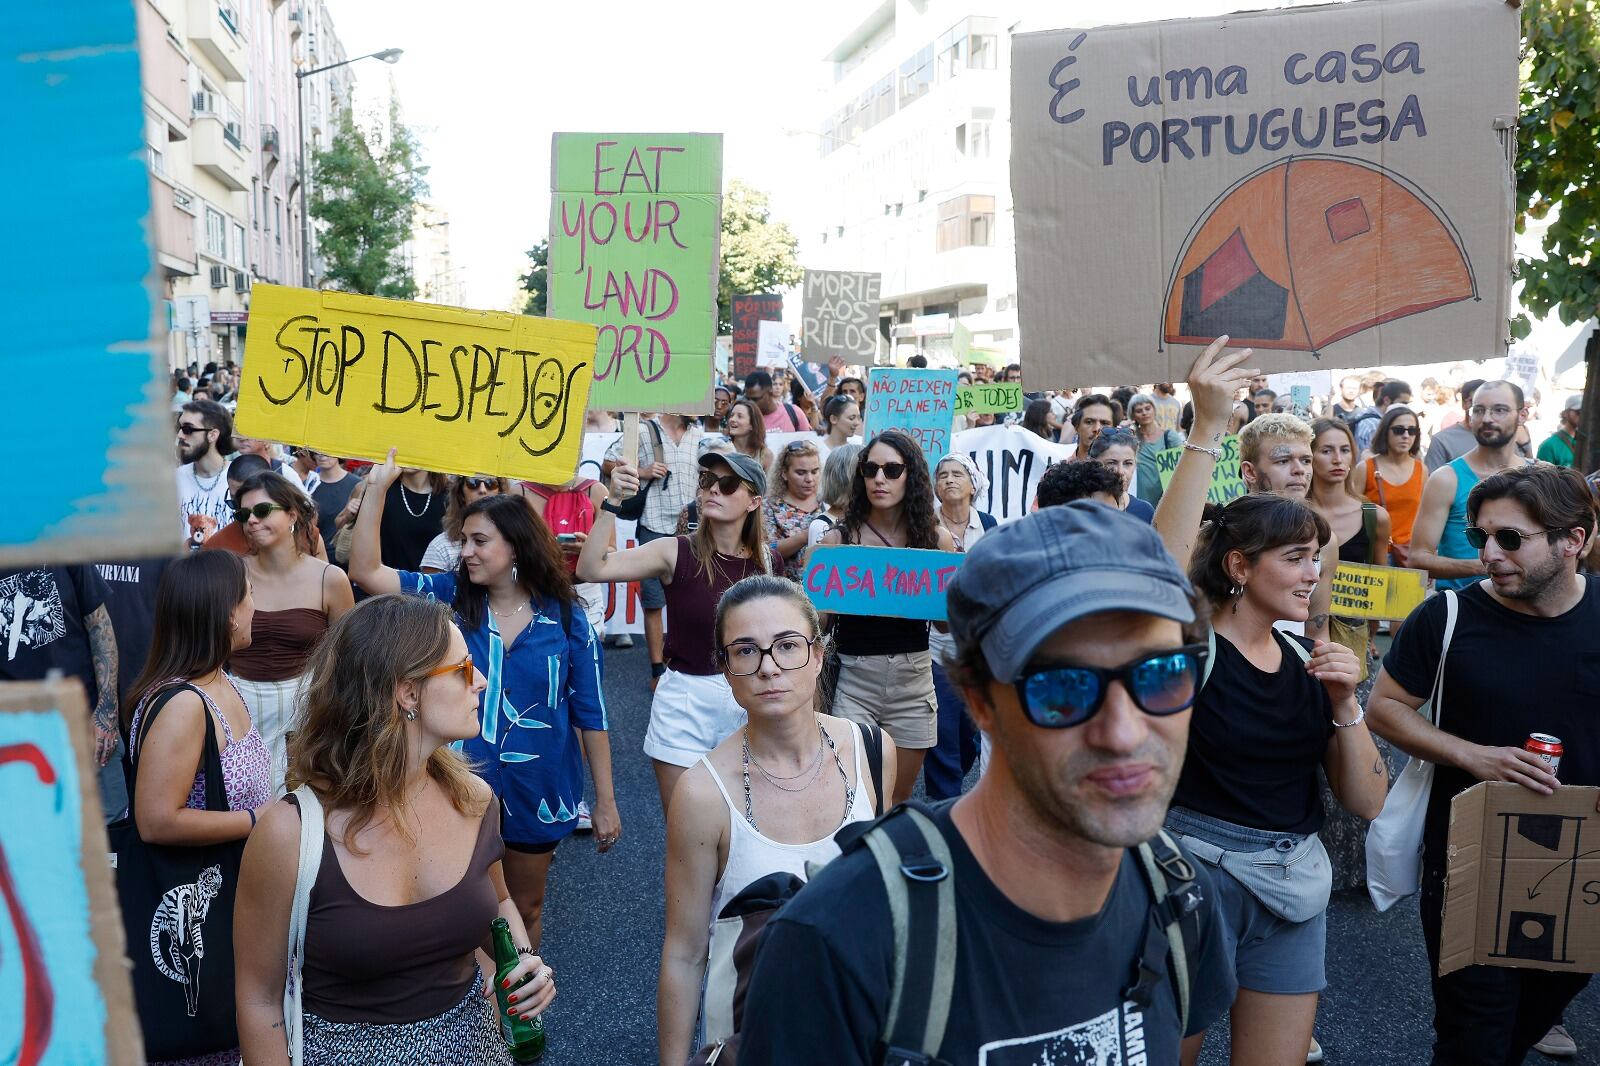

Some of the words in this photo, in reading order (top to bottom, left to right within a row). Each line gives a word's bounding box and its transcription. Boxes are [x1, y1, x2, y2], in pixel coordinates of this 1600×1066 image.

[1048, 32, 1088, 125] É
[1127, 64, 1249, 107] uma
[1284, 41, 1426, 86] casa
[1102, 93, 1428, 166] PORTUGUESA
[593, 141, 686, 196] EAT
[562, 198, 689, 275] YOUR
[584, 265, 680, 321] LAND
[807, 272, 882, 304] MORTE
[815, 297, 872, 324] AOS
[593, 323, 672, 386] ORD
[802, 316, 879, 356] RICOS
[259, 315, 366, 407] STOP
[372, 330, 587, 457] DESPEJOS
[869, 400, 880, 412] O
[887, 398, 948, 415] PLANETA
[871, 375, 897, 395] NÃO
[899, 379, 952, 396] DEIXEM
[979, 387, 1019, 410] TODES
[807, 563, 876, 599] CASA
[883, 562, 932, 597] PARA
